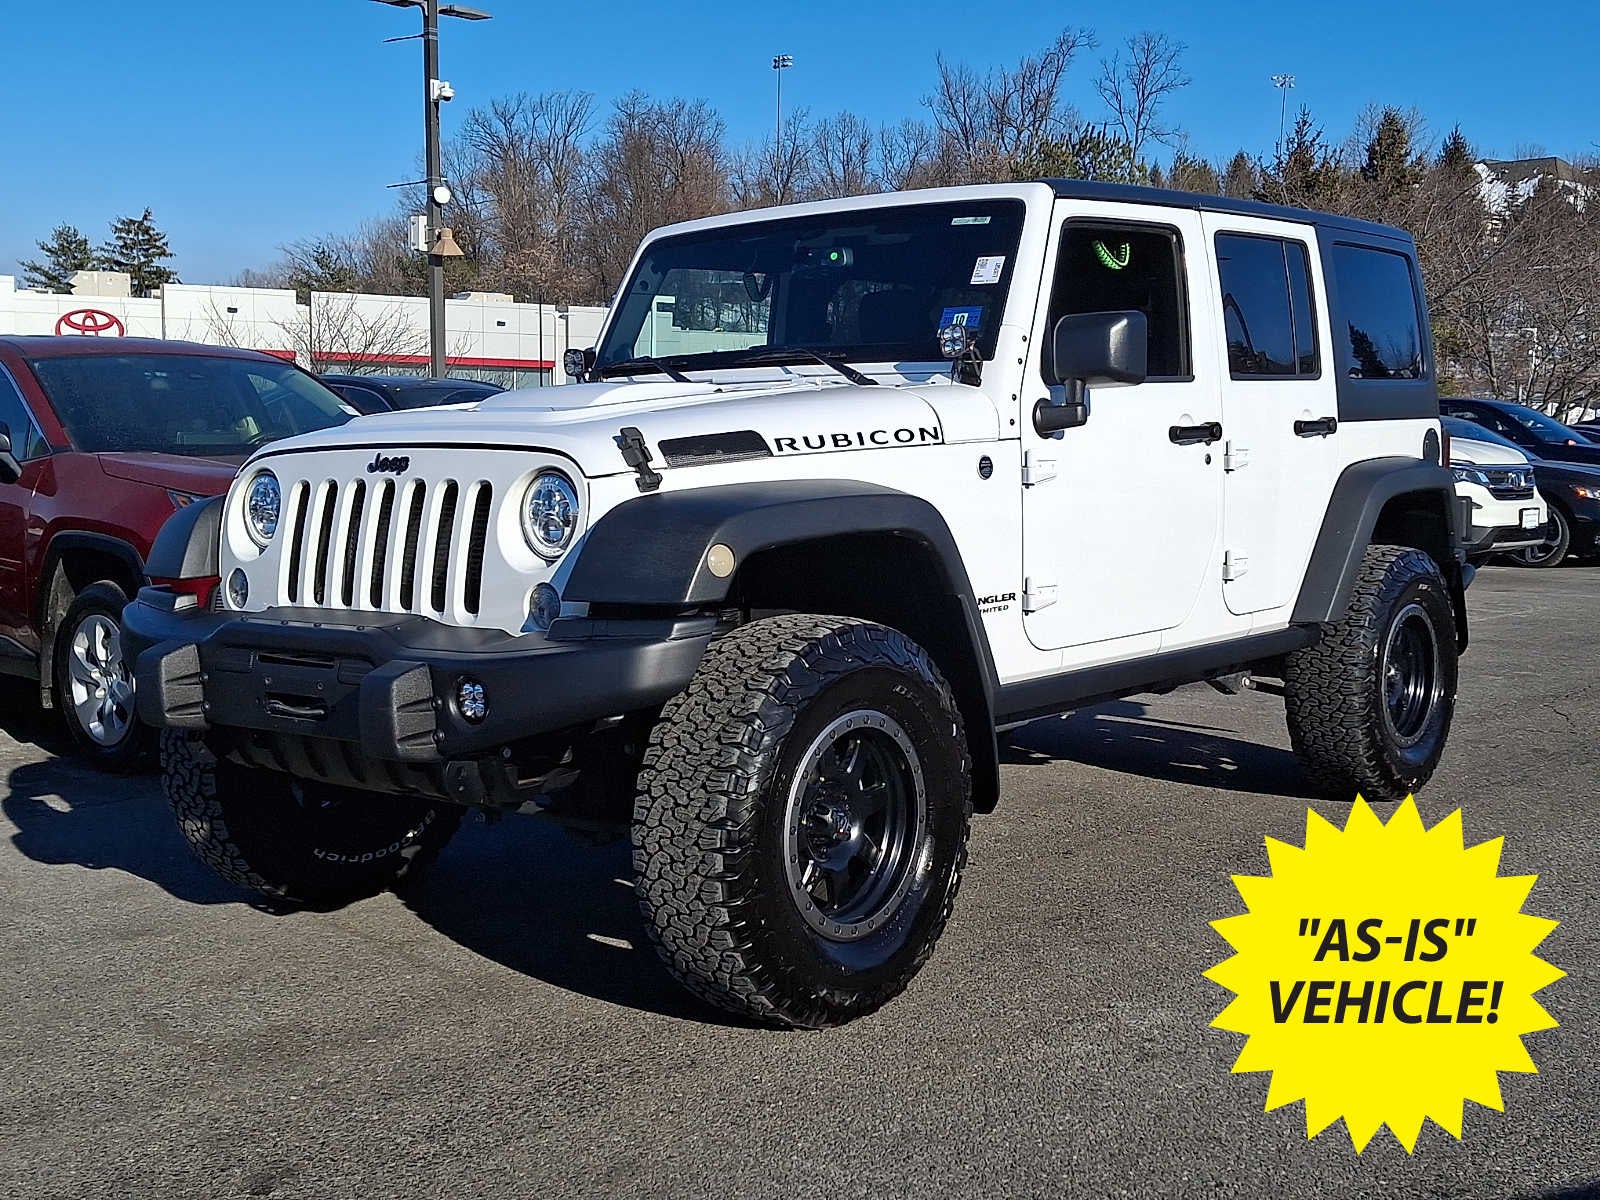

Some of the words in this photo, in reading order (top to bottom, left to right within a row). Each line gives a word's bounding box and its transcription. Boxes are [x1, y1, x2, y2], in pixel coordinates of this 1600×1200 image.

[774, 426, 939, 452] RUBICON
[366, 452, 410, 476] Jeep
[977, 592, 1017, 606] NGLER
